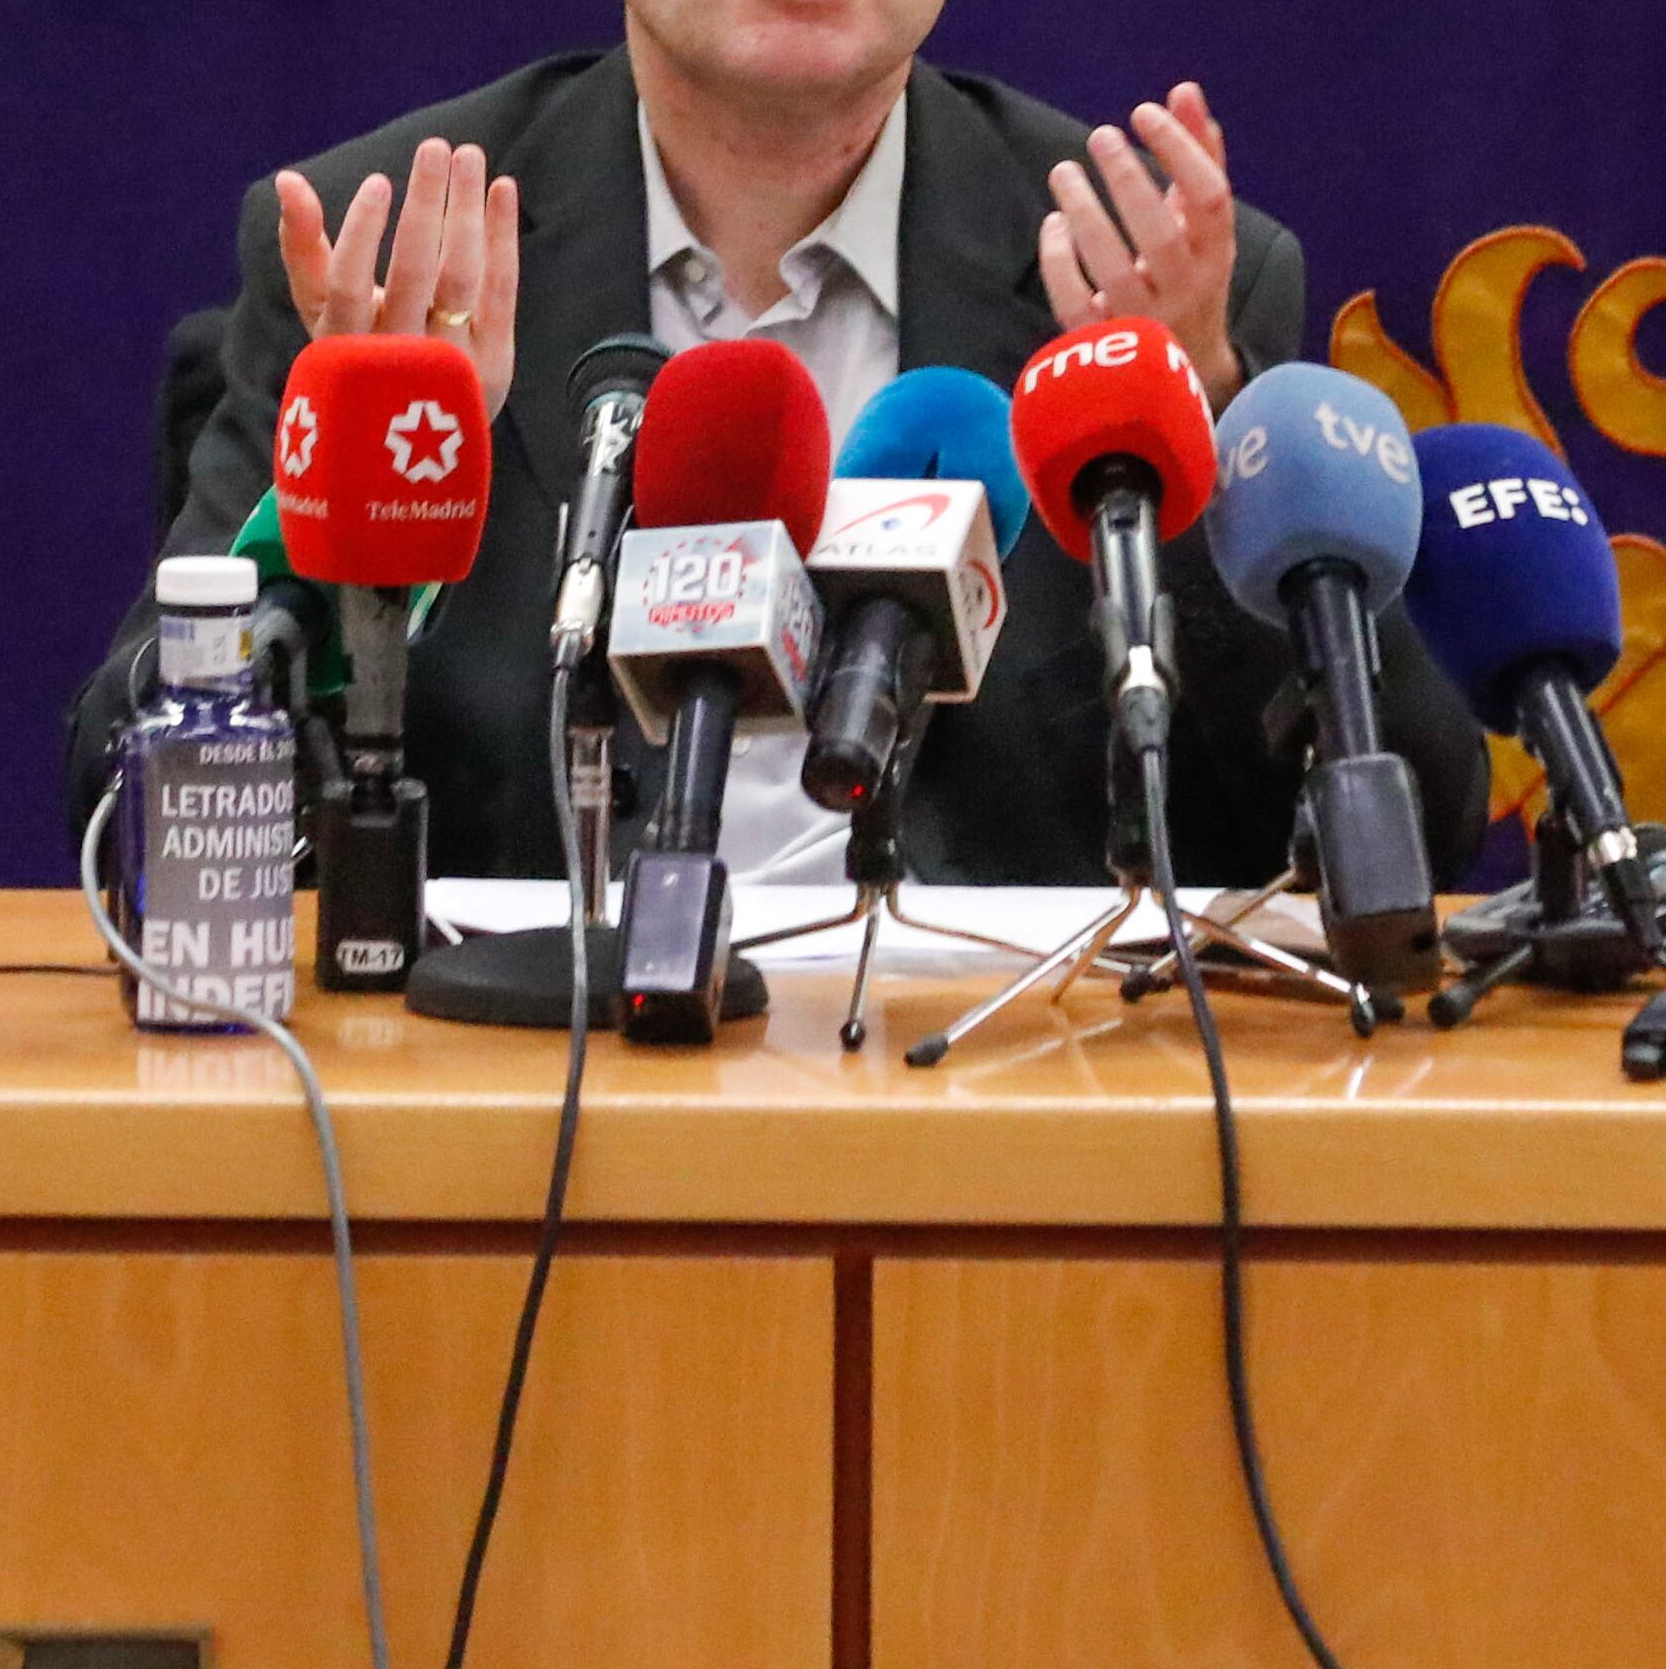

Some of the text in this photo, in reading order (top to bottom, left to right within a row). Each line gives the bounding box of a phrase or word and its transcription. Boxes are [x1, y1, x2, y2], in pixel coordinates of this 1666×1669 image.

[1024, 331, 1139, 395] rne
[1314, 401, 1412, 484] tve
[366, 497, 477, 521] TeleMadrid
[1449, 478, 1589, 529] EFE:
[817, 541, 938, 557] ATLAS
[649, 551, 743, 604] 120
[199, 743, 255, 764] DESDE
[198, 867, 243, 901] DE
[142, 919, 210, 968] EN
